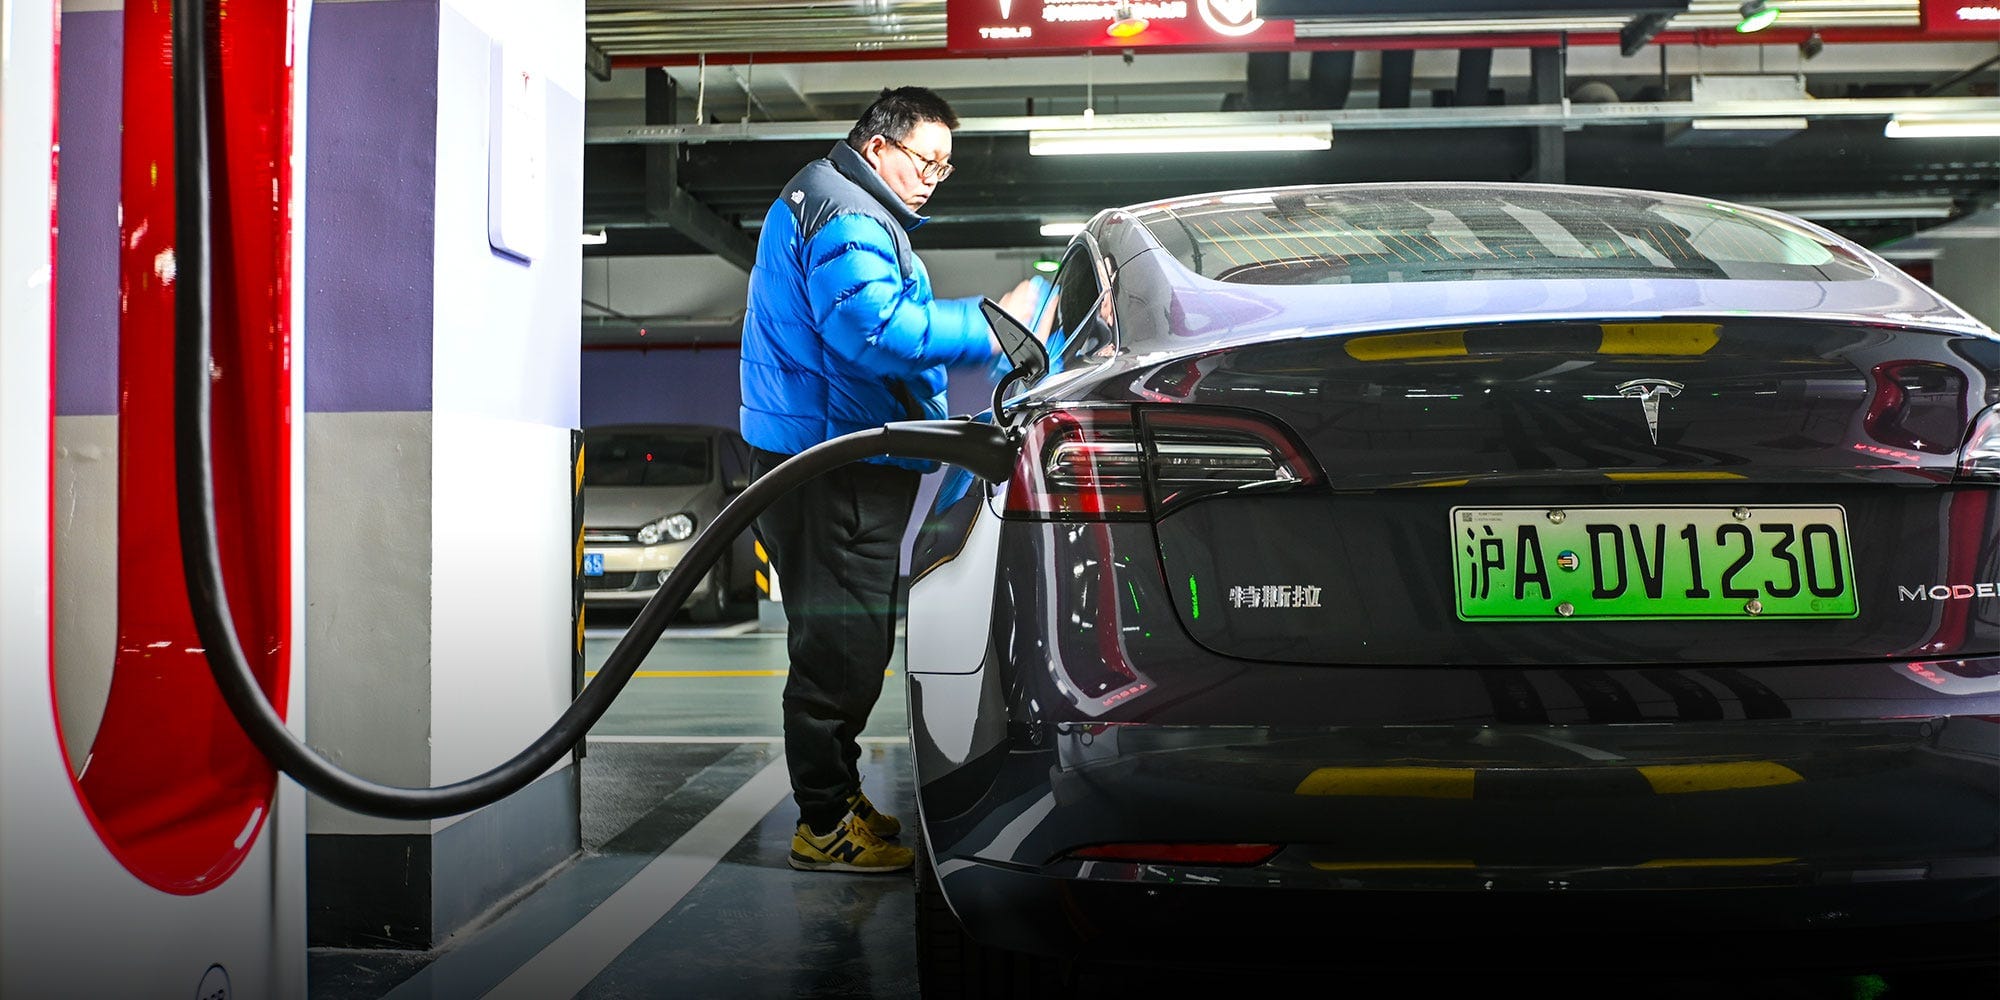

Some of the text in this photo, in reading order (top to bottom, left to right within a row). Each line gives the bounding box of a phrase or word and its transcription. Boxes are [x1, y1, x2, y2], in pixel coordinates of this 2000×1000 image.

[1229, 585, 1322, 609] 特斯拉
[1898, 582, 2000, 602] MODE
